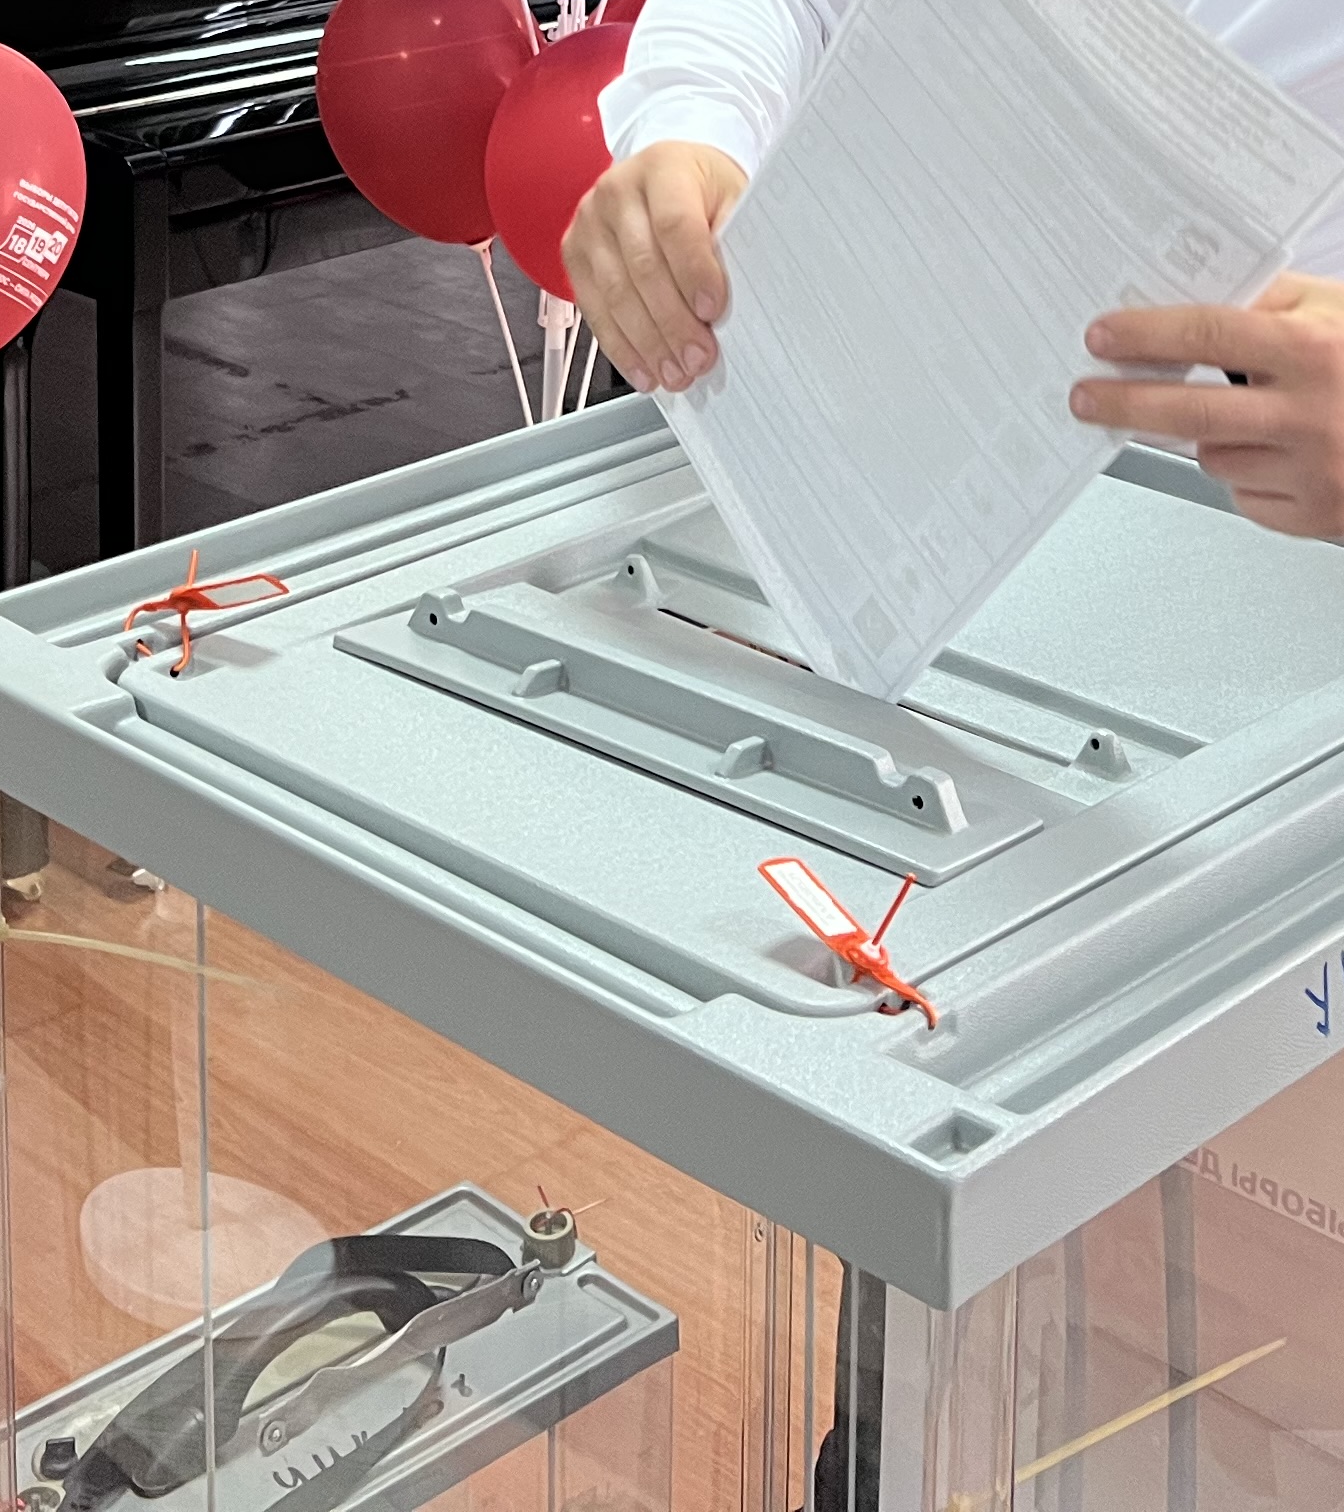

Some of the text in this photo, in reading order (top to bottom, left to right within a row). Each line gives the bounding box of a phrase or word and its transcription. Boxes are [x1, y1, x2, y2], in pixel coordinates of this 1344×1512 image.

[8, 234, 27, 254] 18
[31, 236, 46, 254] 19
[48, 237, 63, 256] 20
